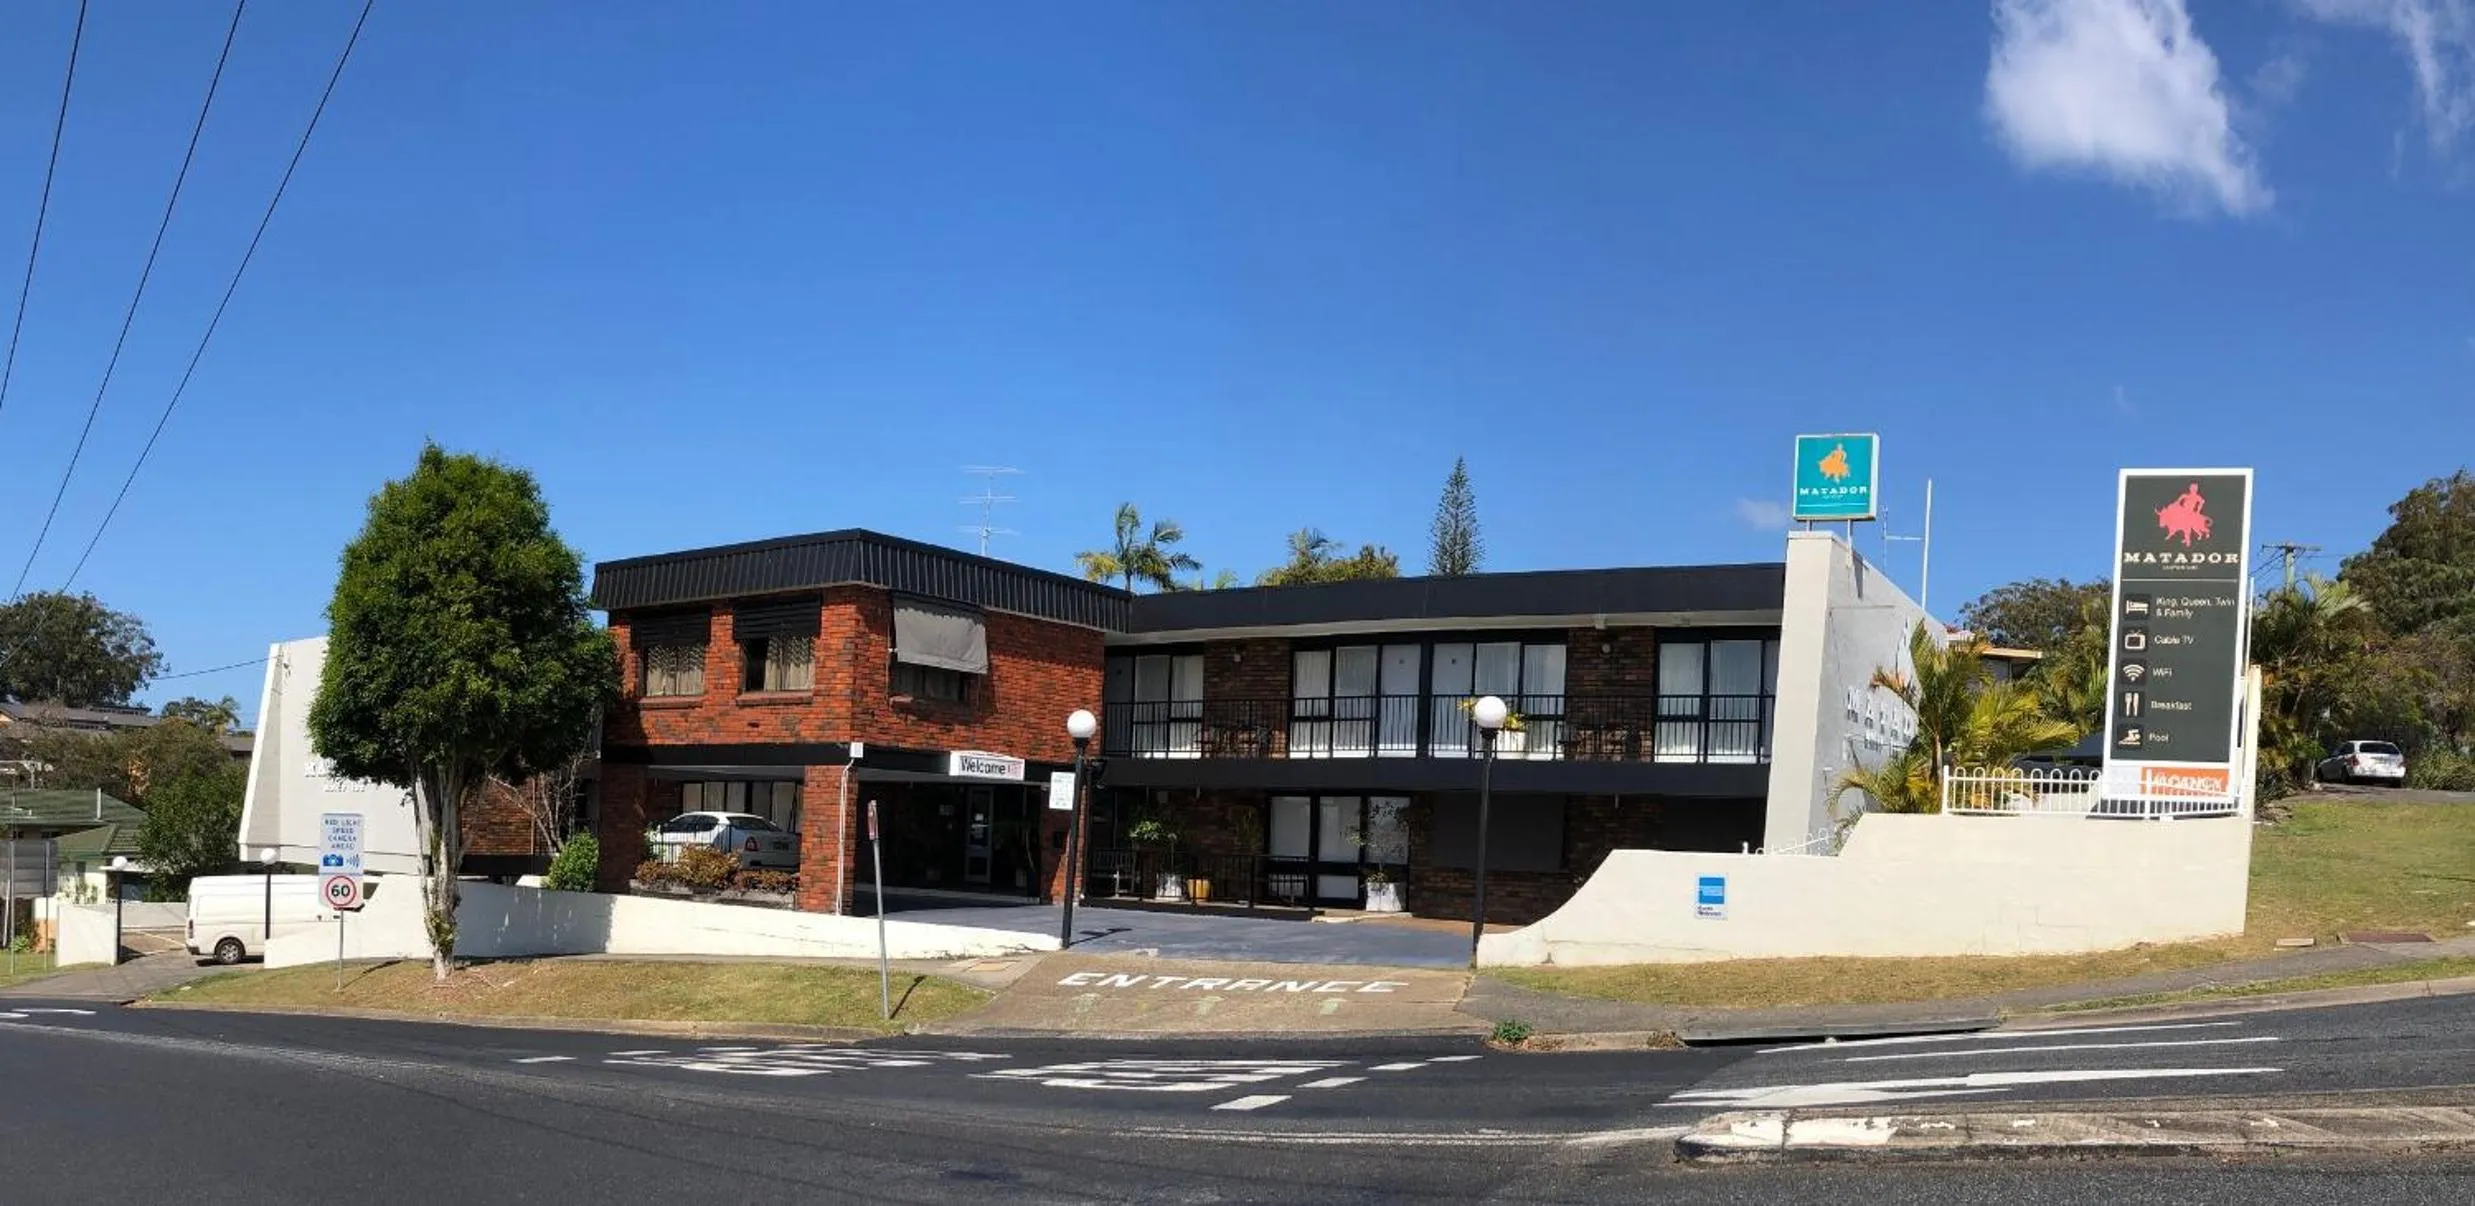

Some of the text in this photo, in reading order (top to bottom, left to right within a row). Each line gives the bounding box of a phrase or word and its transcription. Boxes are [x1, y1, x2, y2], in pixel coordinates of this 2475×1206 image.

[1799, 486, 1868, 497] MATADOR
[2123, 552, 2240, 564] MATADOR
[2215, 597, 2236, 607] Twin
[2164, 608, 2194, 620] Family
[2154, 635, 2195, 645] Cable TV
[2150, 701, 2193, 711] Breakfast
[2149, 733, 2169, 743] Pool
[960, 756, 1006, 775] Welcome
[331, 884, 351, 898] 60
[1057, 972, 1410, 993] ENTRANCE
